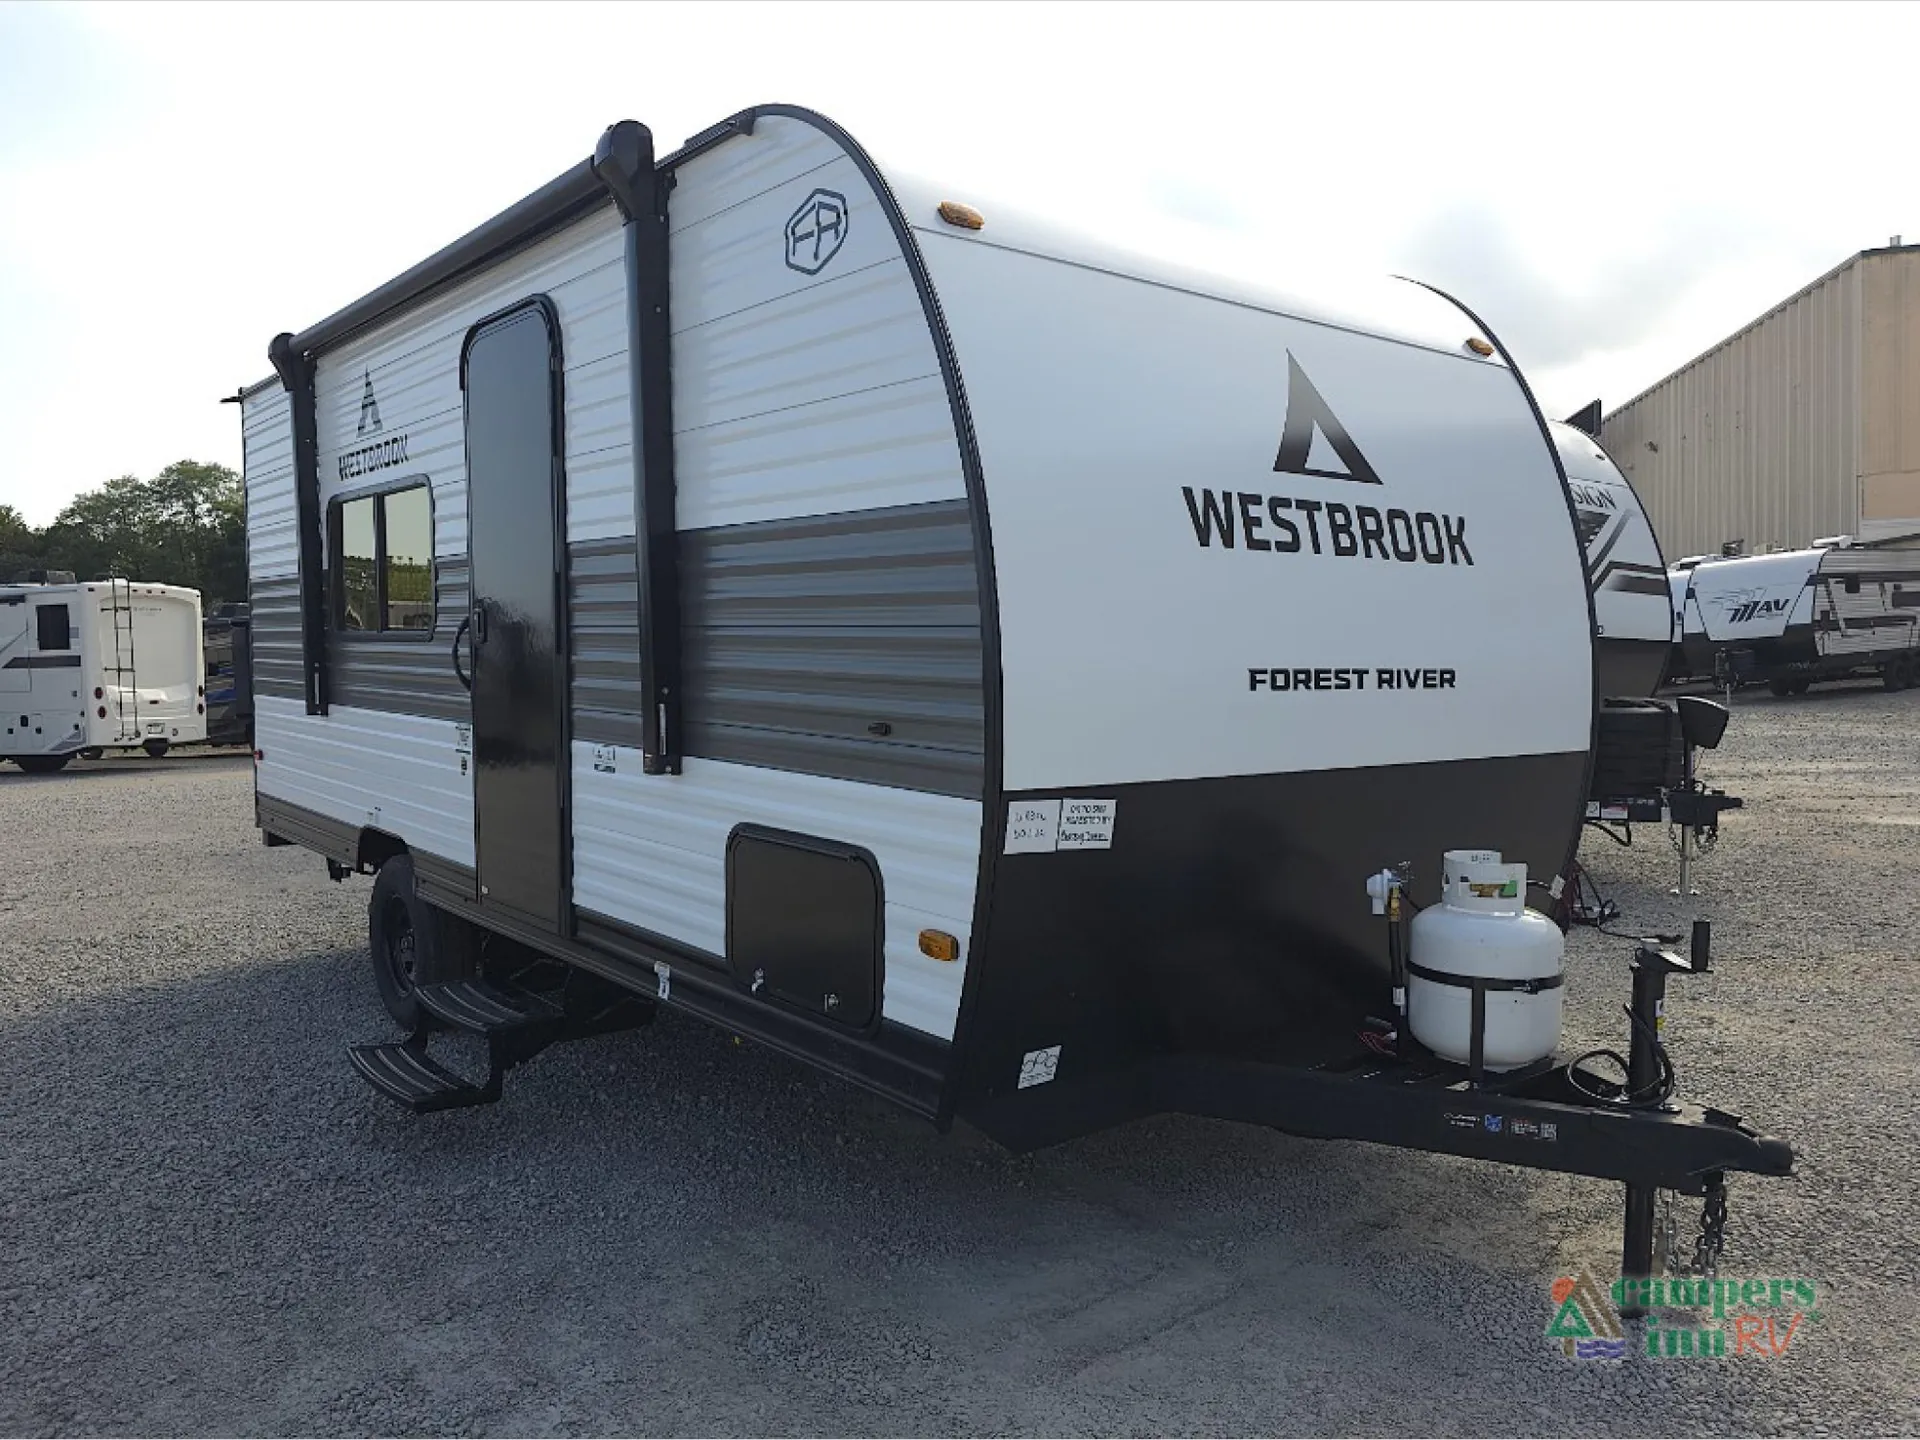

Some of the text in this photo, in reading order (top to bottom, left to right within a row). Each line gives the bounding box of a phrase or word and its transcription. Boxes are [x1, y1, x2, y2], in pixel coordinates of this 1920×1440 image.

[338, 434, 410, 481] WESTBROOK
[1181, 485, 1474, 566] WESTBROOK
[1247, 667, 1456, 691] FOREST RIVER
